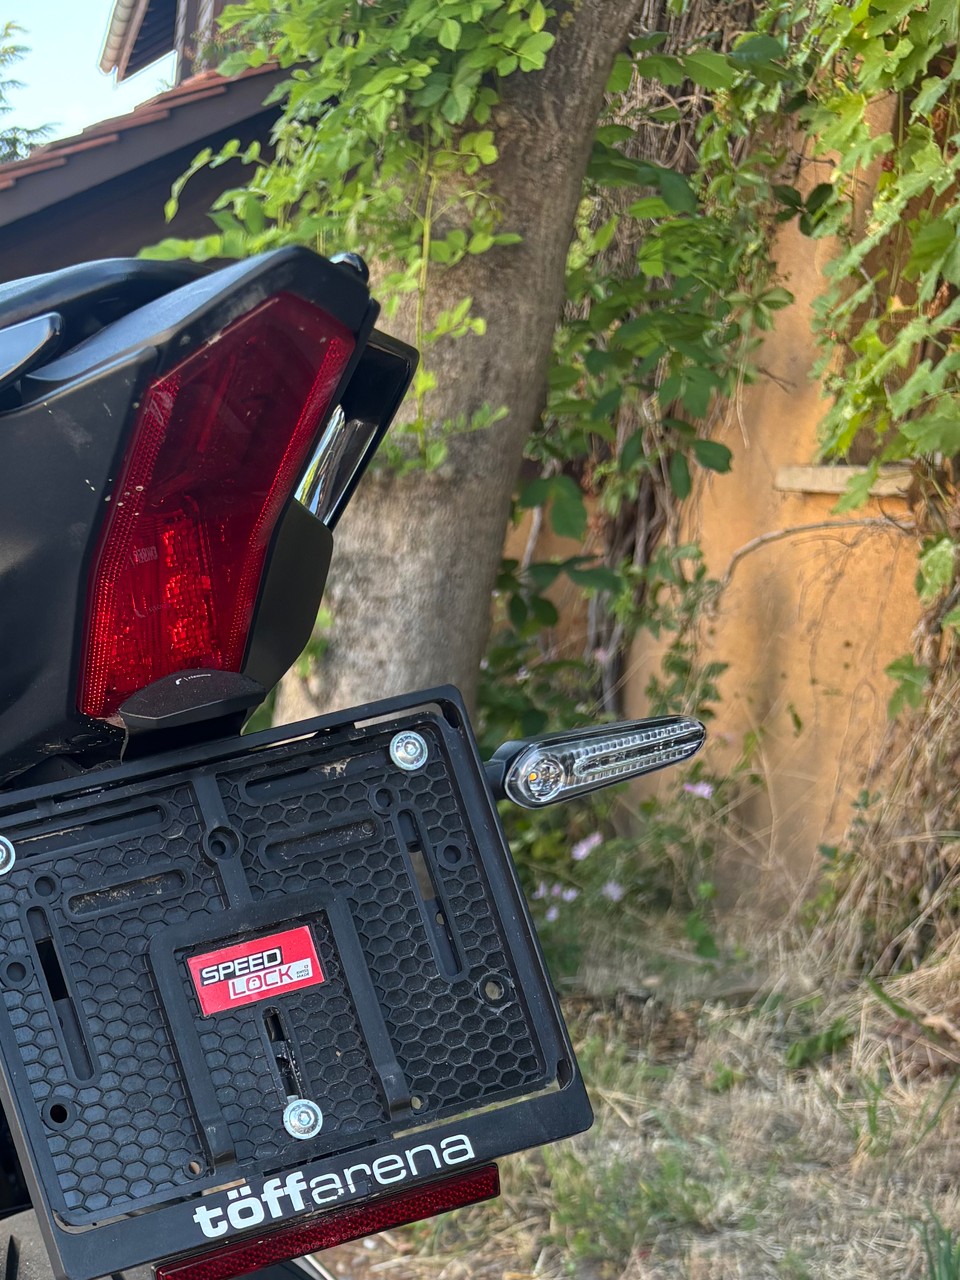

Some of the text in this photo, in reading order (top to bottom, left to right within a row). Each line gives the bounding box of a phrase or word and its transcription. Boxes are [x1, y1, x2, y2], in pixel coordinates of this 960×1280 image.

[201, 948, 282, 986] SPEED
[231, 965, 294, 997] LOCK
[193, 1134, 475, 1238] töffarena
